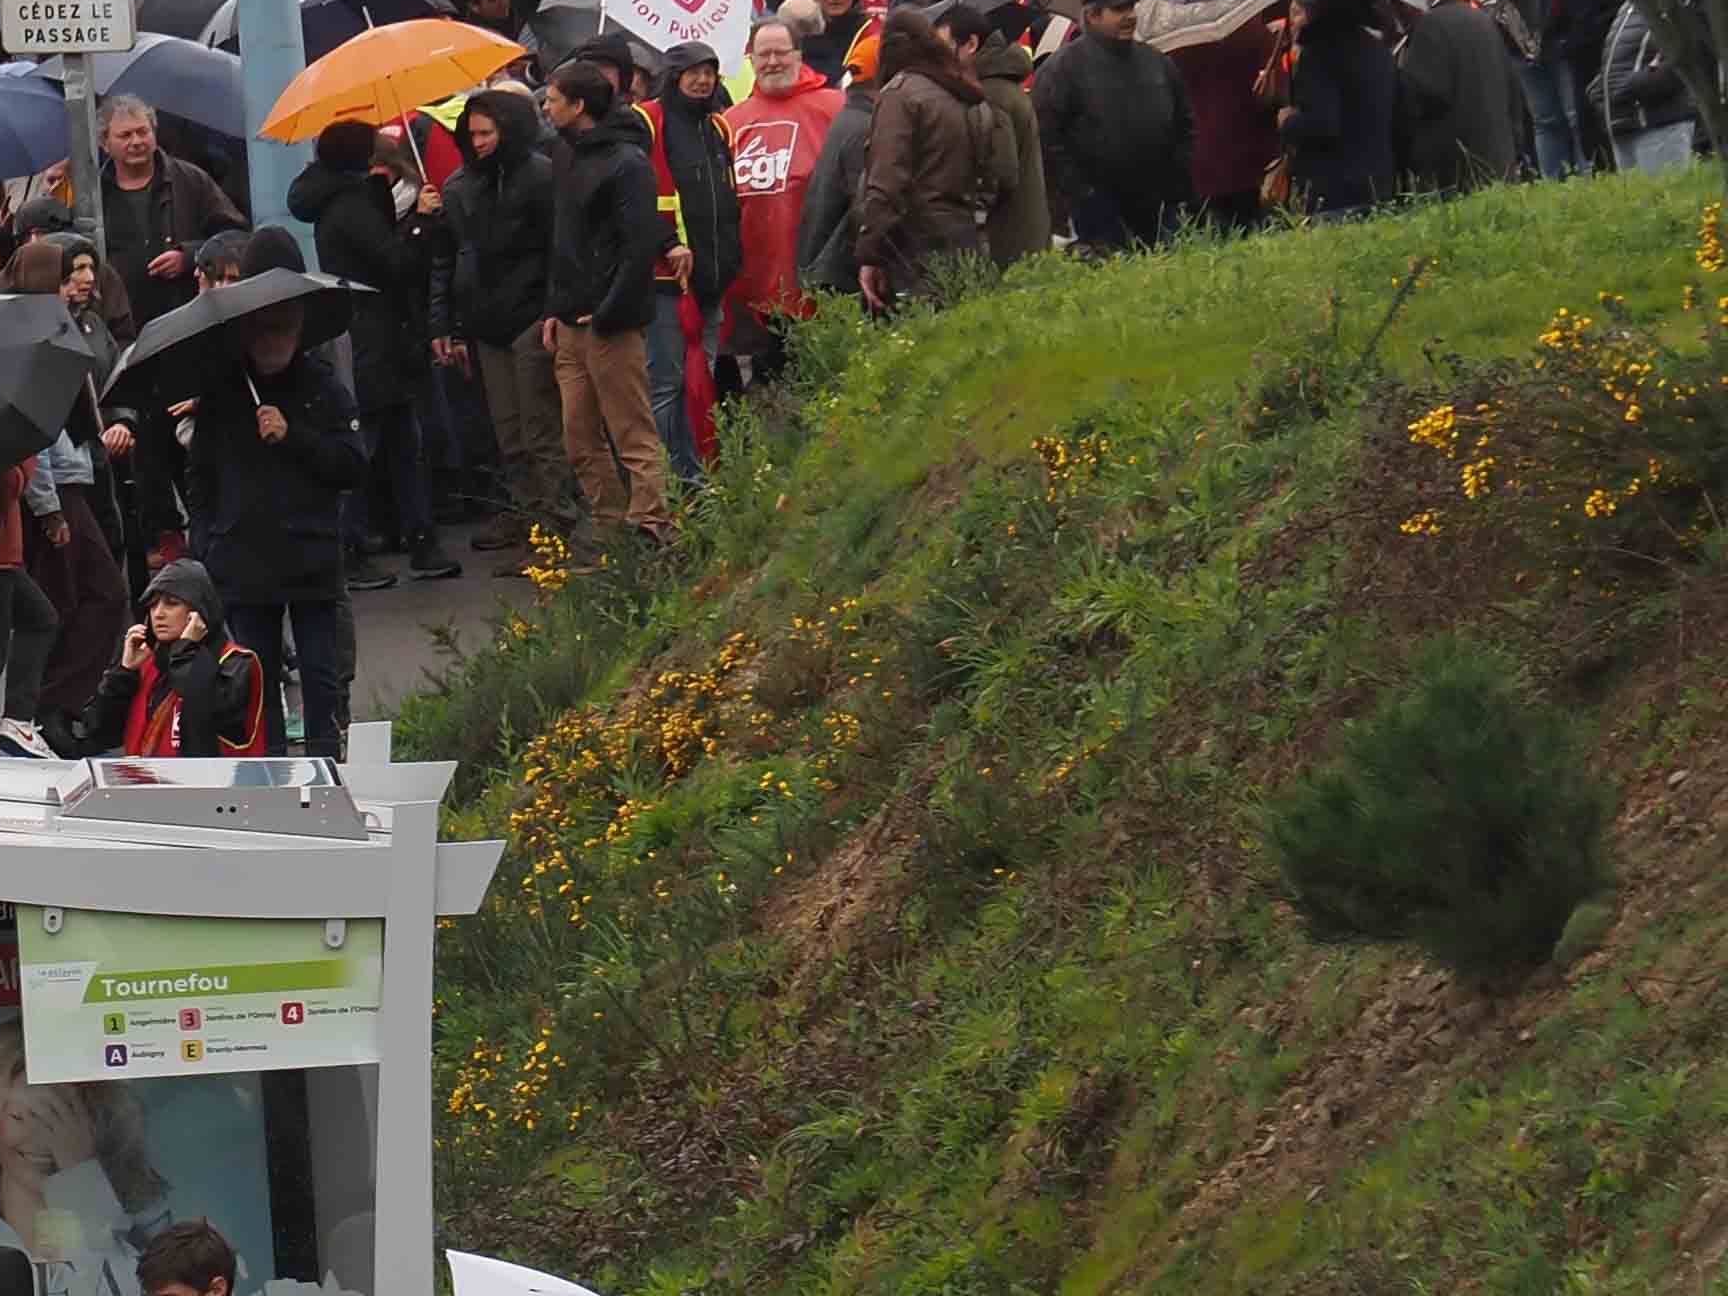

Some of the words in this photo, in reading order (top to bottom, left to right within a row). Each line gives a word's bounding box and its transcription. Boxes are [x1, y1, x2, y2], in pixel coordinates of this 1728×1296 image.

[19, 2, 81, 20] CÉDEZ
[91, 3, 113, 19] LE
[24, 27, 110, 43] PASSAGE
[734, 150, 789, 189] cgt
[101, 971, 229, 997] Tournefou
[110, 1049, 123, 1064] A
[187, 1042, 198, 1058] E
